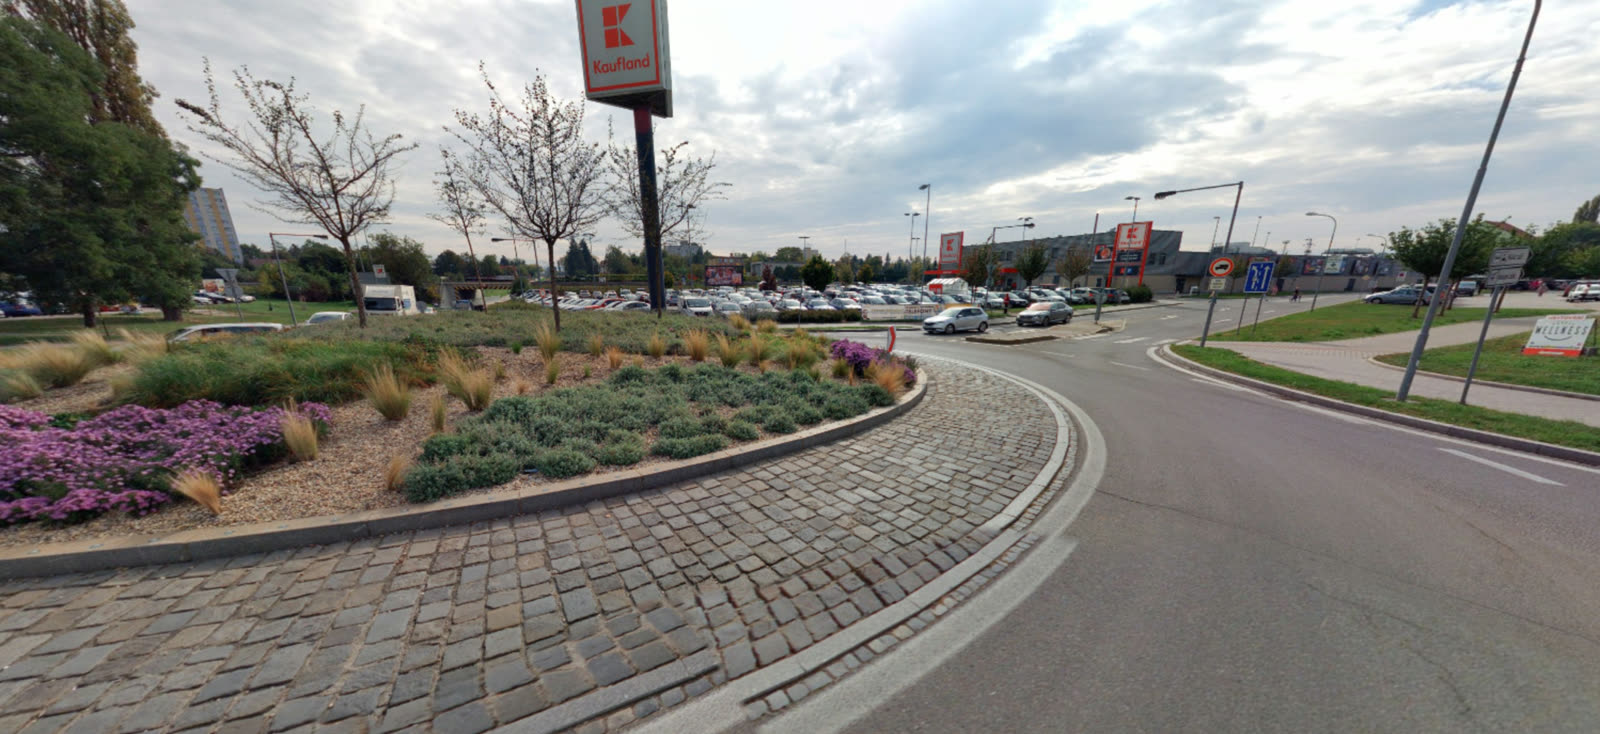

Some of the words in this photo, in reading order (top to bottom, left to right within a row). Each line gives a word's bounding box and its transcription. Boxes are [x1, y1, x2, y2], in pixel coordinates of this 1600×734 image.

[602, 3, 635, 48] K
[592, 52, 650, 74] Kaufland
[1535, 326, 1589, 335] WELLNESS
